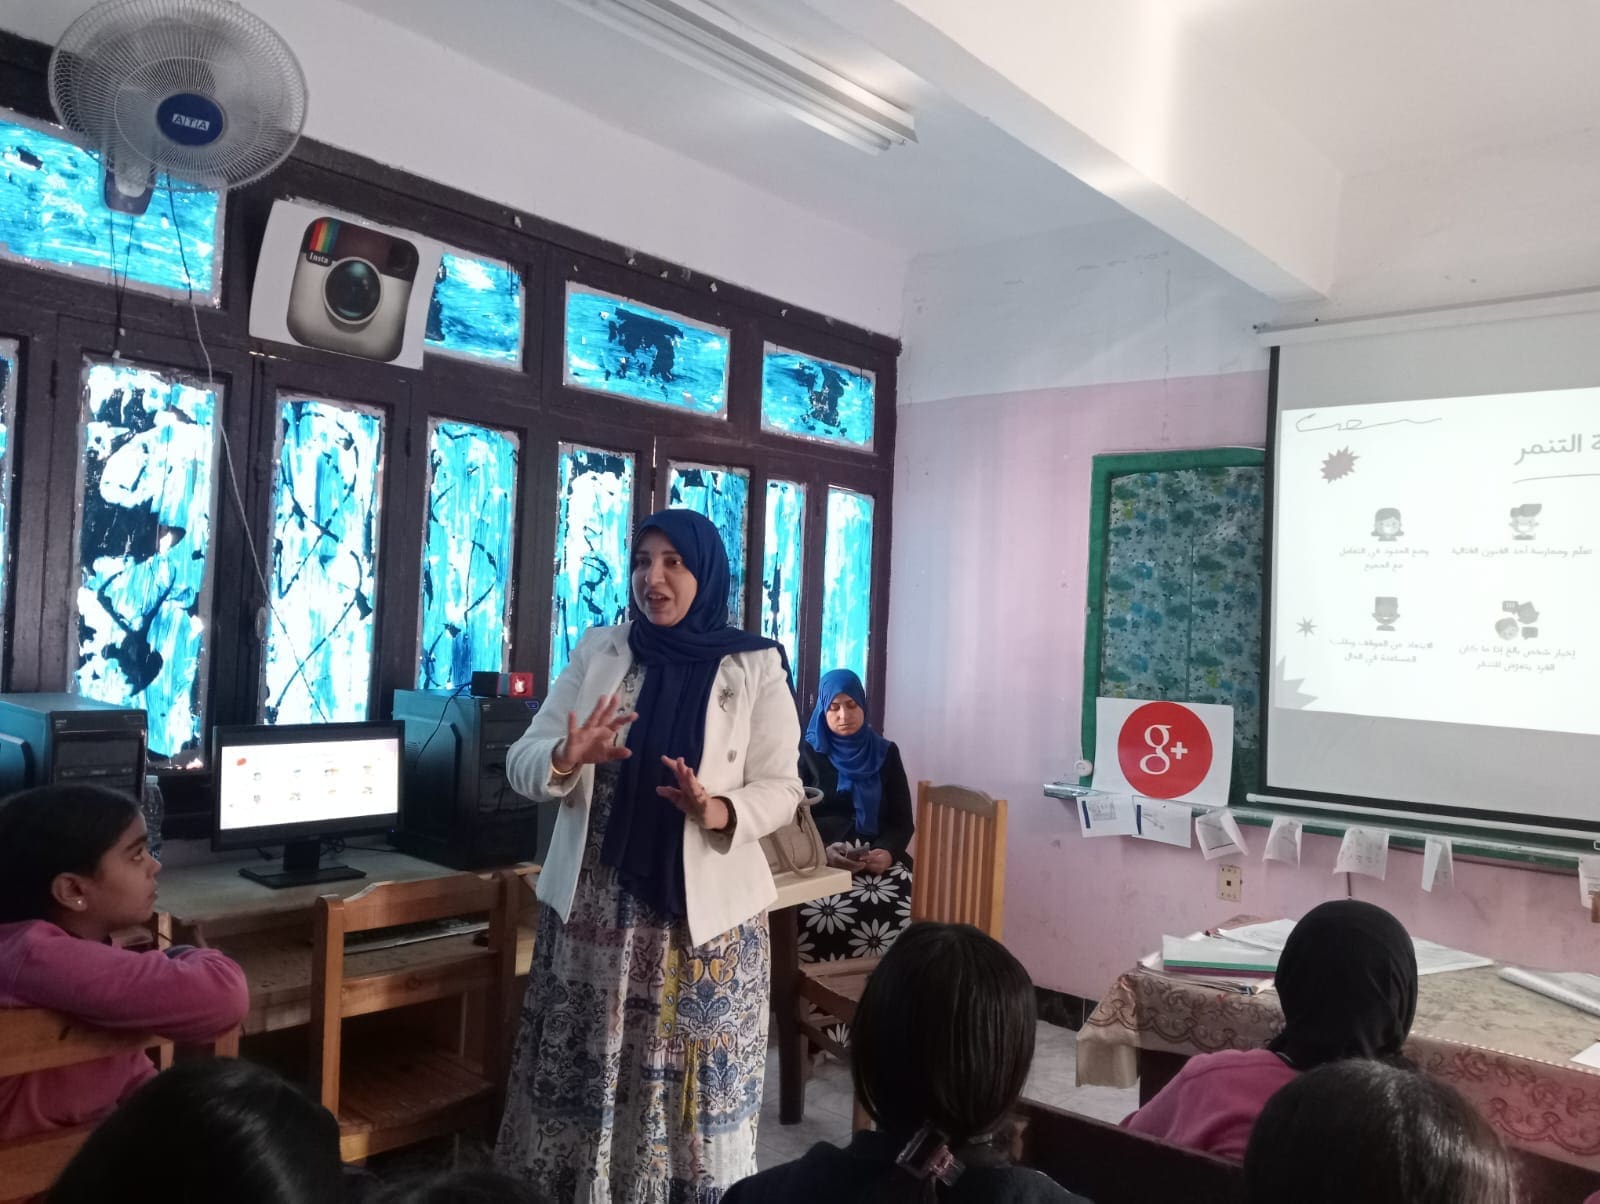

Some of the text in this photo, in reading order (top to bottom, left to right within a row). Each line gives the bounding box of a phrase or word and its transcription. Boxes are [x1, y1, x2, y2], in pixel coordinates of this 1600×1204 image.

[309, 251, 329, 264] Insta
[1513, 433, 1582, 466] التنمر
[1139, 724, 1188, 775] g+
